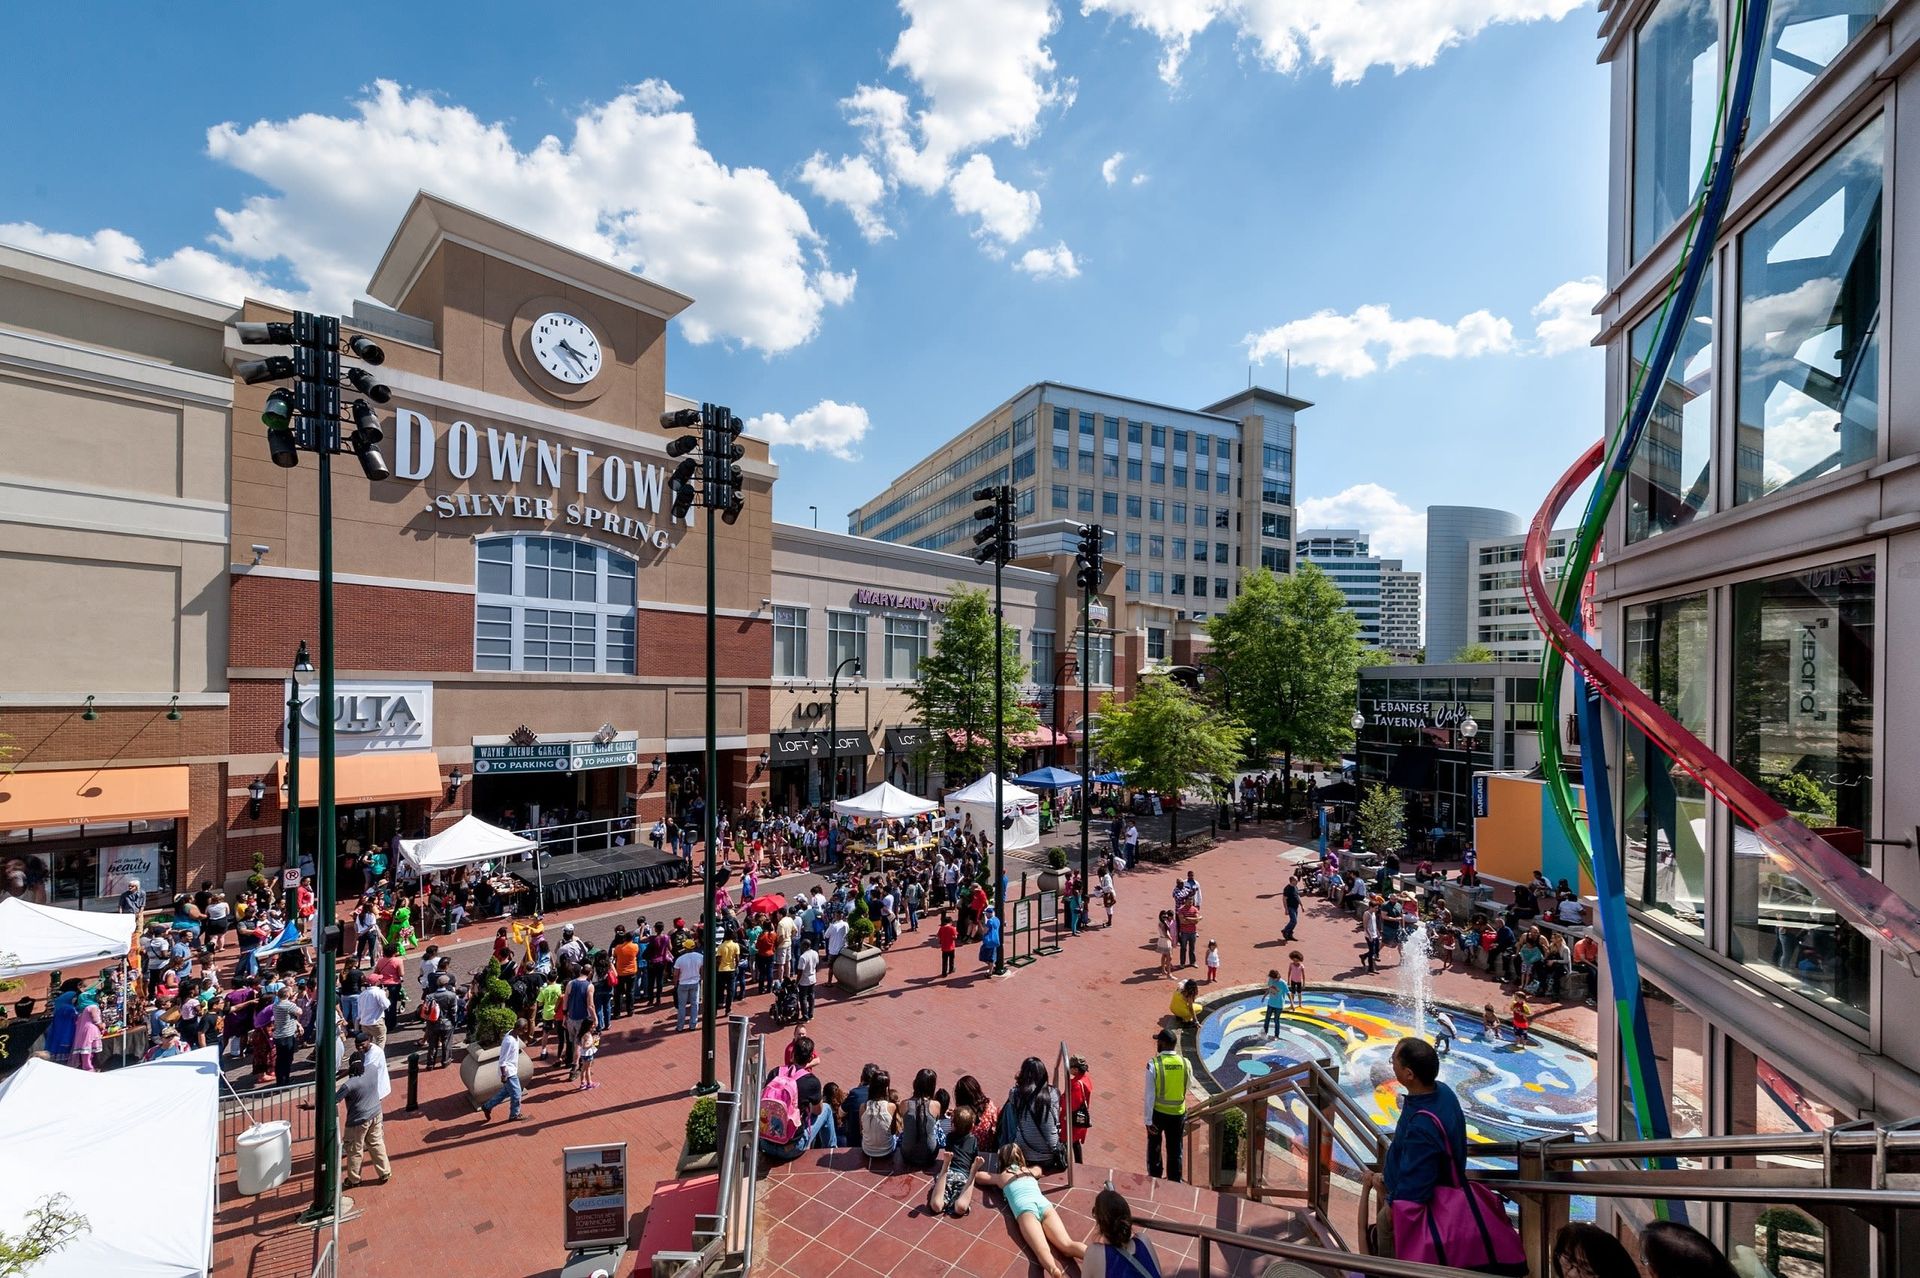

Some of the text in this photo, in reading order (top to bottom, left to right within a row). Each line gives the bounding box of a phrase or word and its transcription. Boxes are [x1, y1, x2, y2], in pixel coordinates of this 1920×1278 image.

[549, 318, 559, 327] 11
[563, 318, 574, 326] 12
[434, 494, 671, 550] SILVER SPRING
[857, 589, 928, 611] MARYLAND
[797, 701, 839, 719] LOF
[1373, 699, 1429, 714] LEBANESE
[346, 721, 424, 729] BEAUTY
[1373, 713, 1427, 729] TAVERNA
[480, 745, 565, 758] WAYNE AVENUE GARAGE
[615, 741, 634, 751] GARAGE
[778, 740, 809, 752] LOFT
[491, 760, 555, 770] TO PARKING
[596, 755, 627, 764] PARKING
[107, 860, 151, 874] beauty
